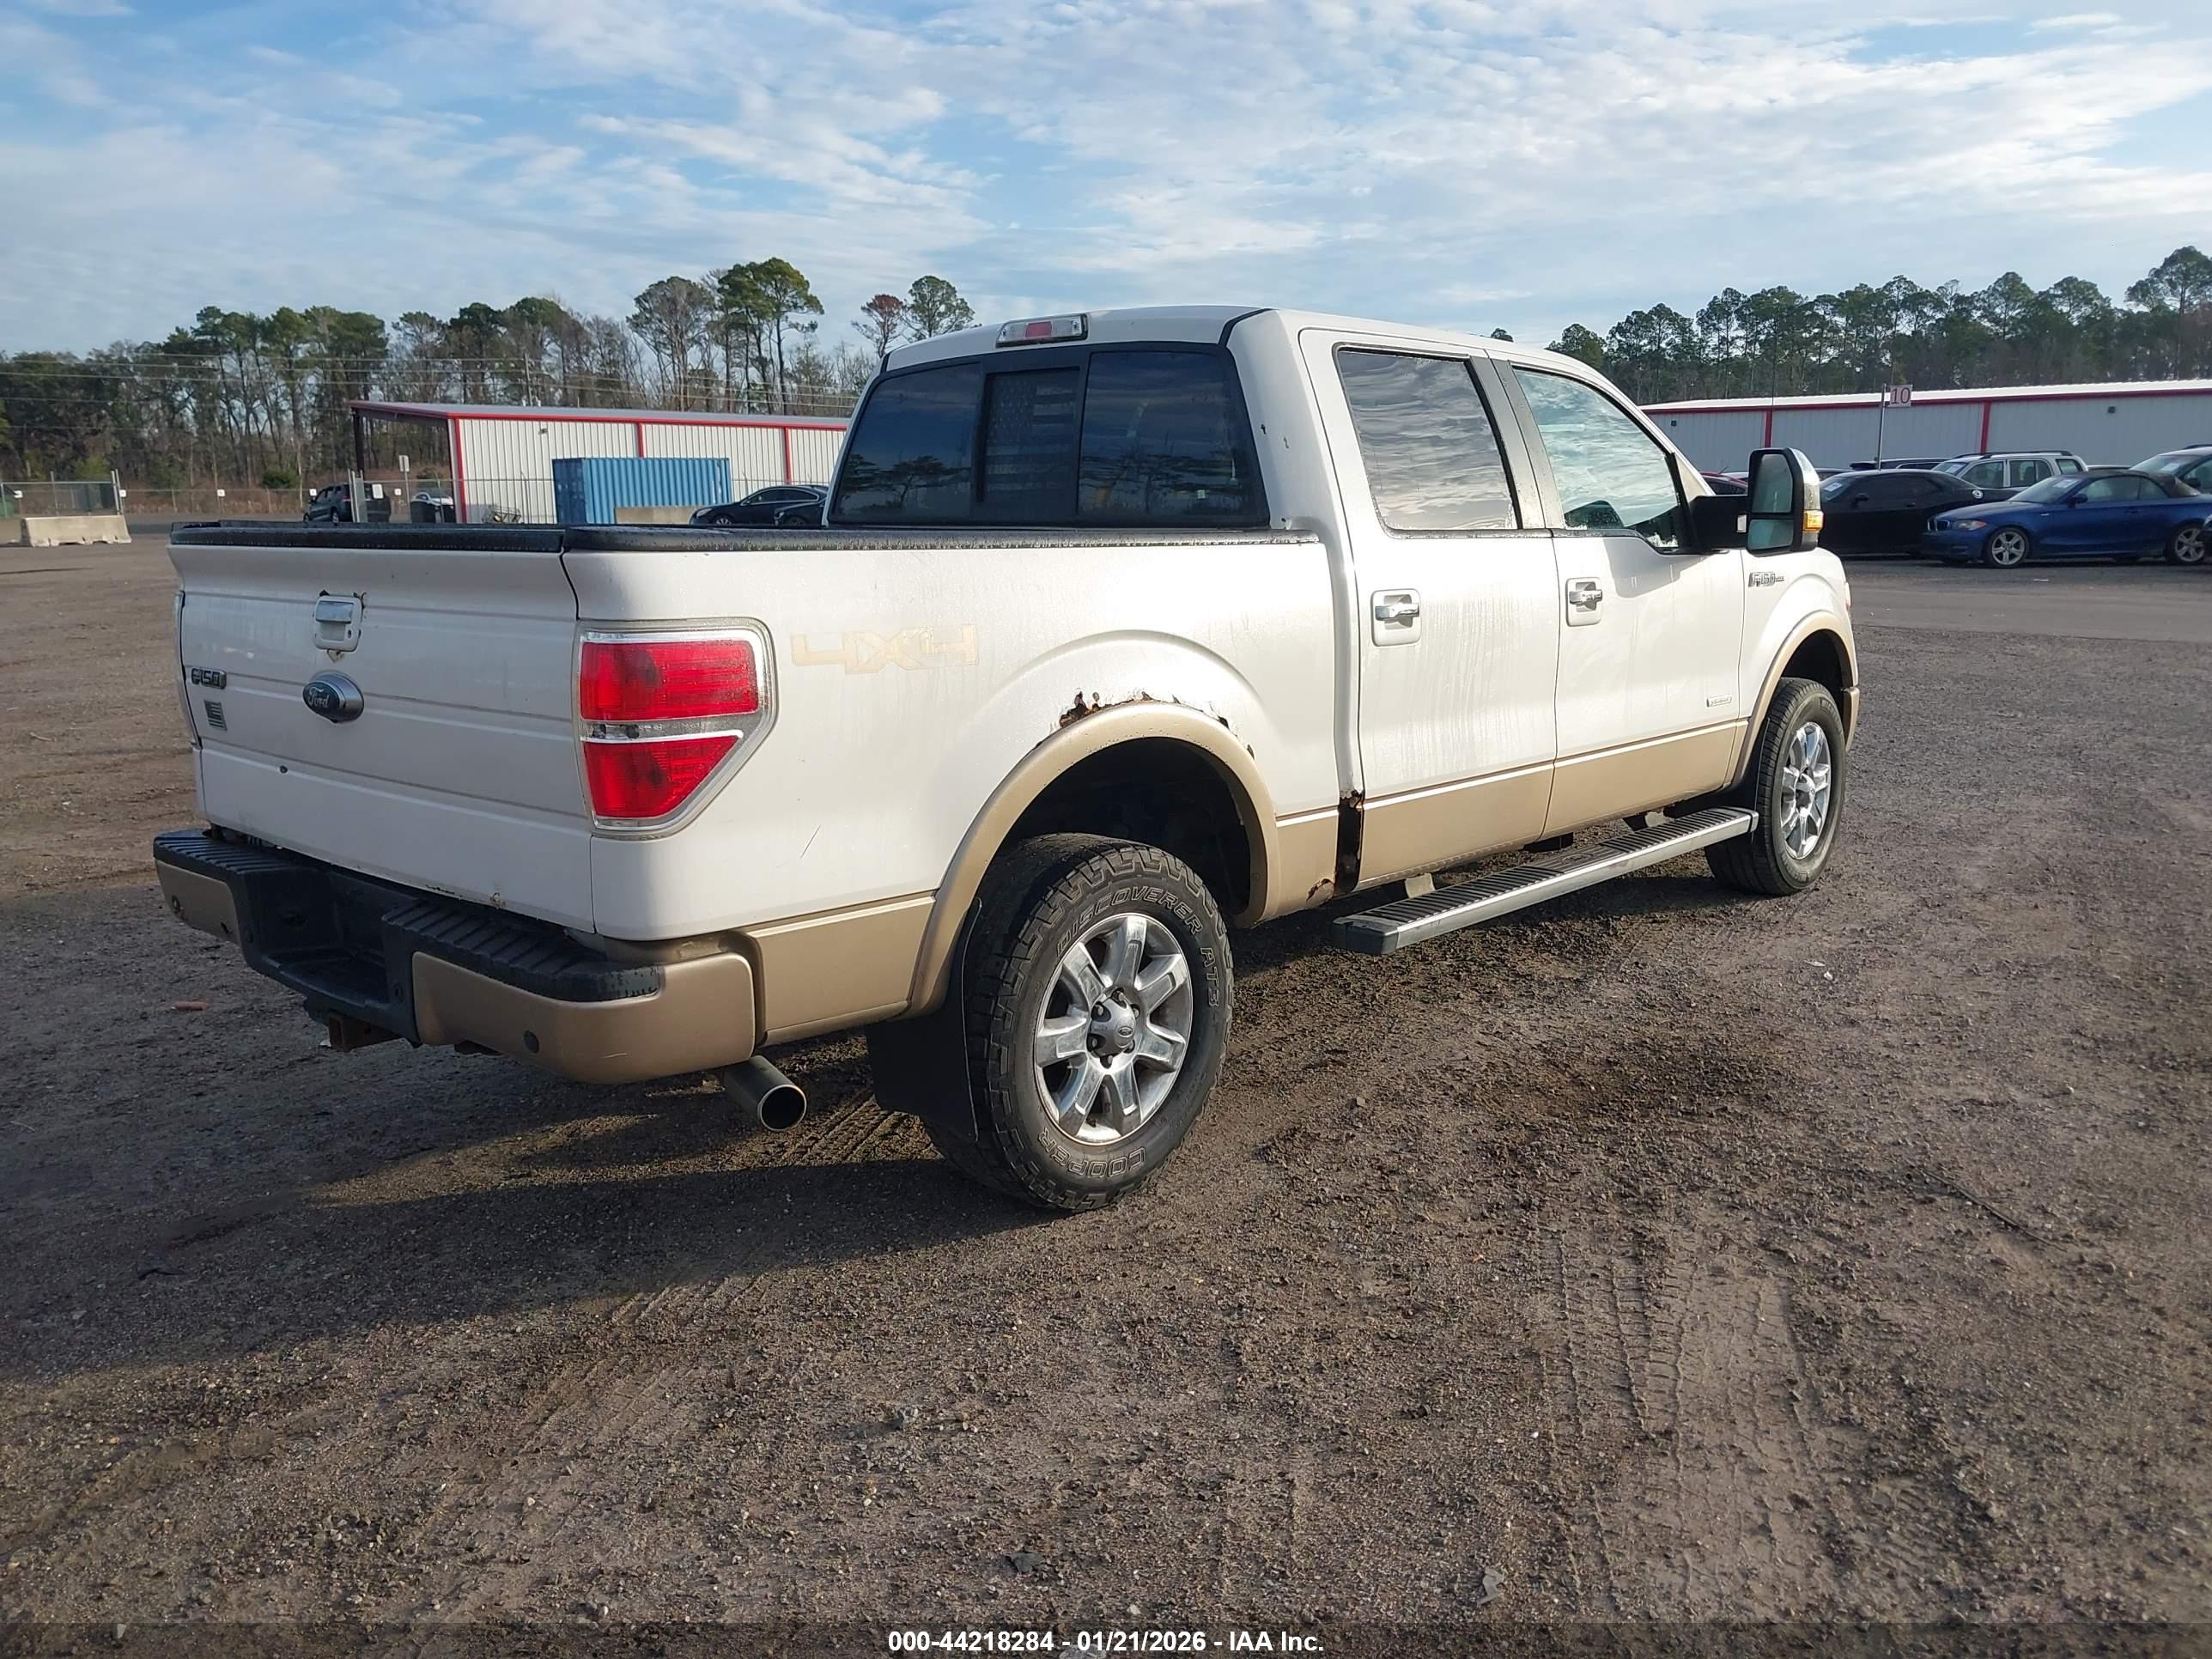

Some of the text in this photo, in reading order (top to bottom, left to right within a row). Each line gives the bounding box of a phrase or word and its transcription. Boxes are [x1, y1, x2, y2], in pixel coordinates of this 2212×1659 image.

[1891, 387, 1911, 404] 10
[307, 687, 330, 709] Ford
[1055, 884, 1221, 1008] DISCOVERER AT3
[1036, 1127, 1146, 1178] COOPER
